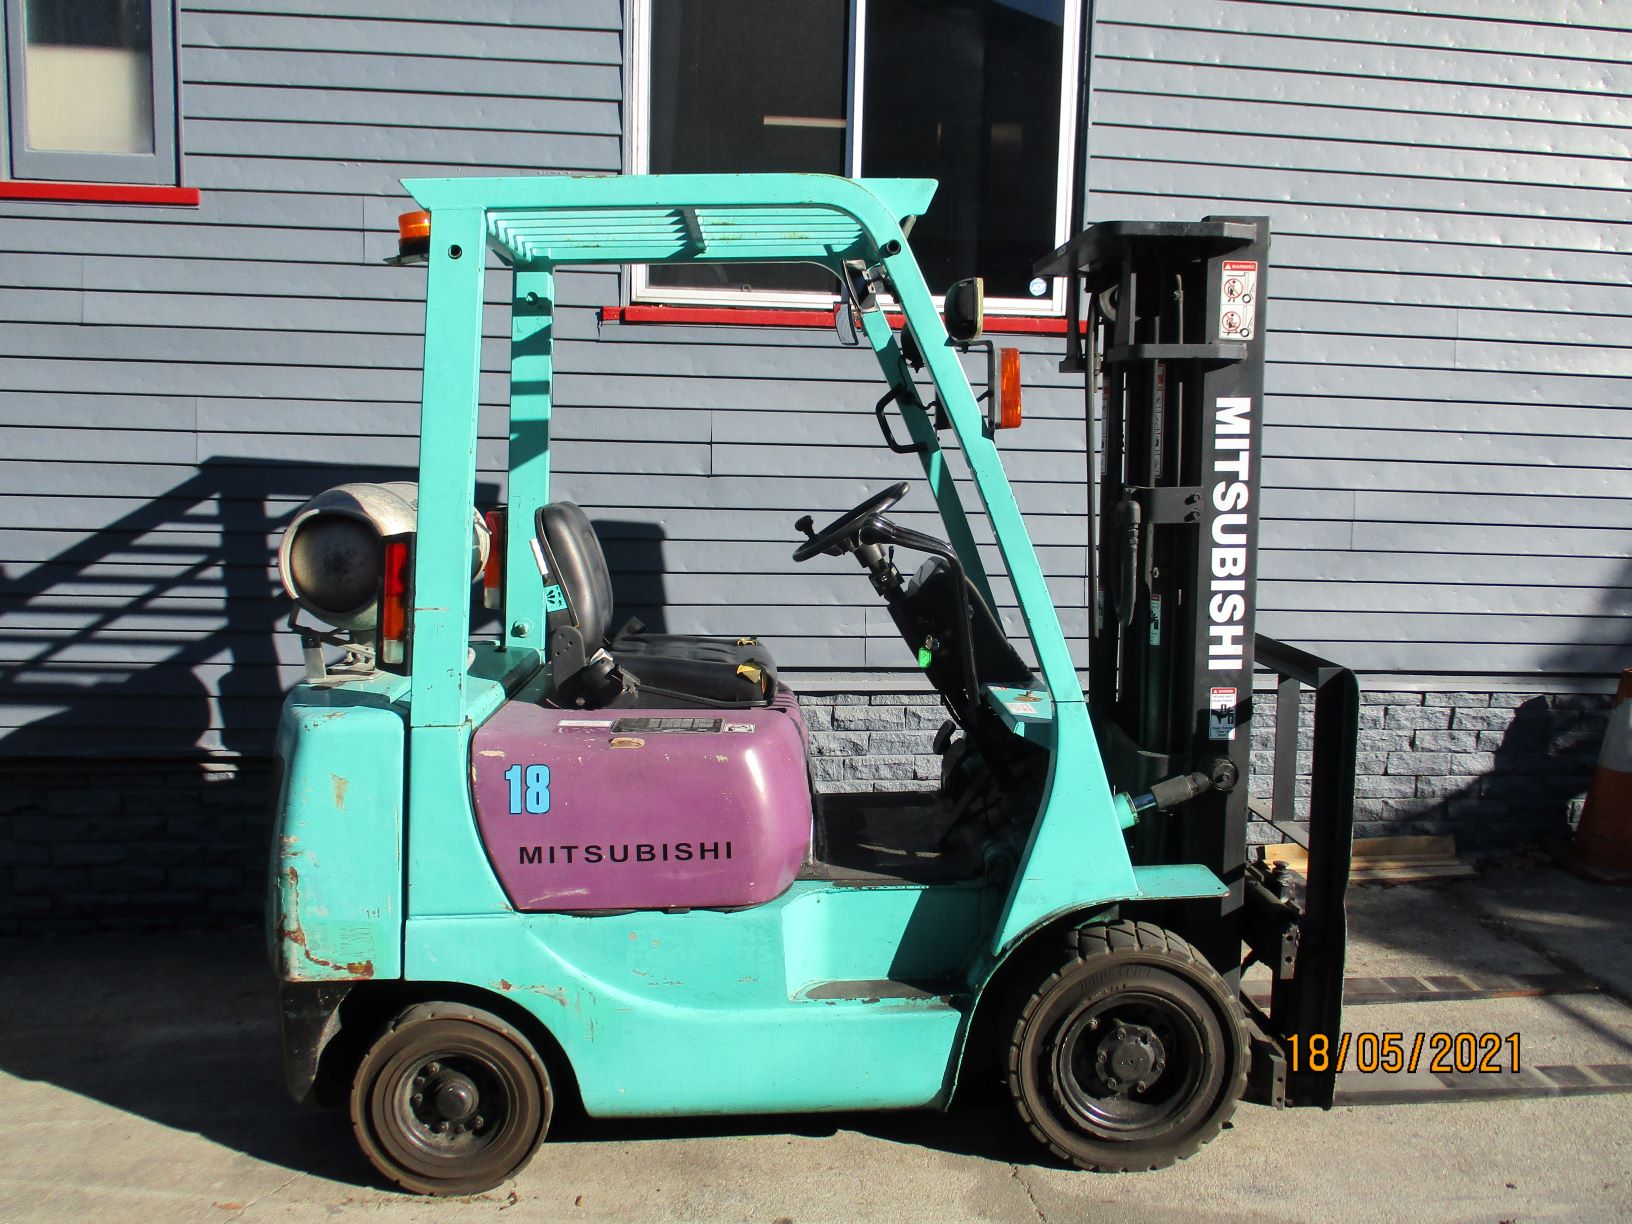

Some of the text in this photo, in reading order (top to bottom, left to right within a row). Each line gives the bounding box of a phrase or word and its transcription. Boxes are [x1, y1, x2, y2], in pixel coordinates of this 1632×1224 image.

[1208, 396, 1251, 671] MITSUBISHI
[505, 764, 551, 814] 18
[519, 841, 733, 864] MITSUBISHI
